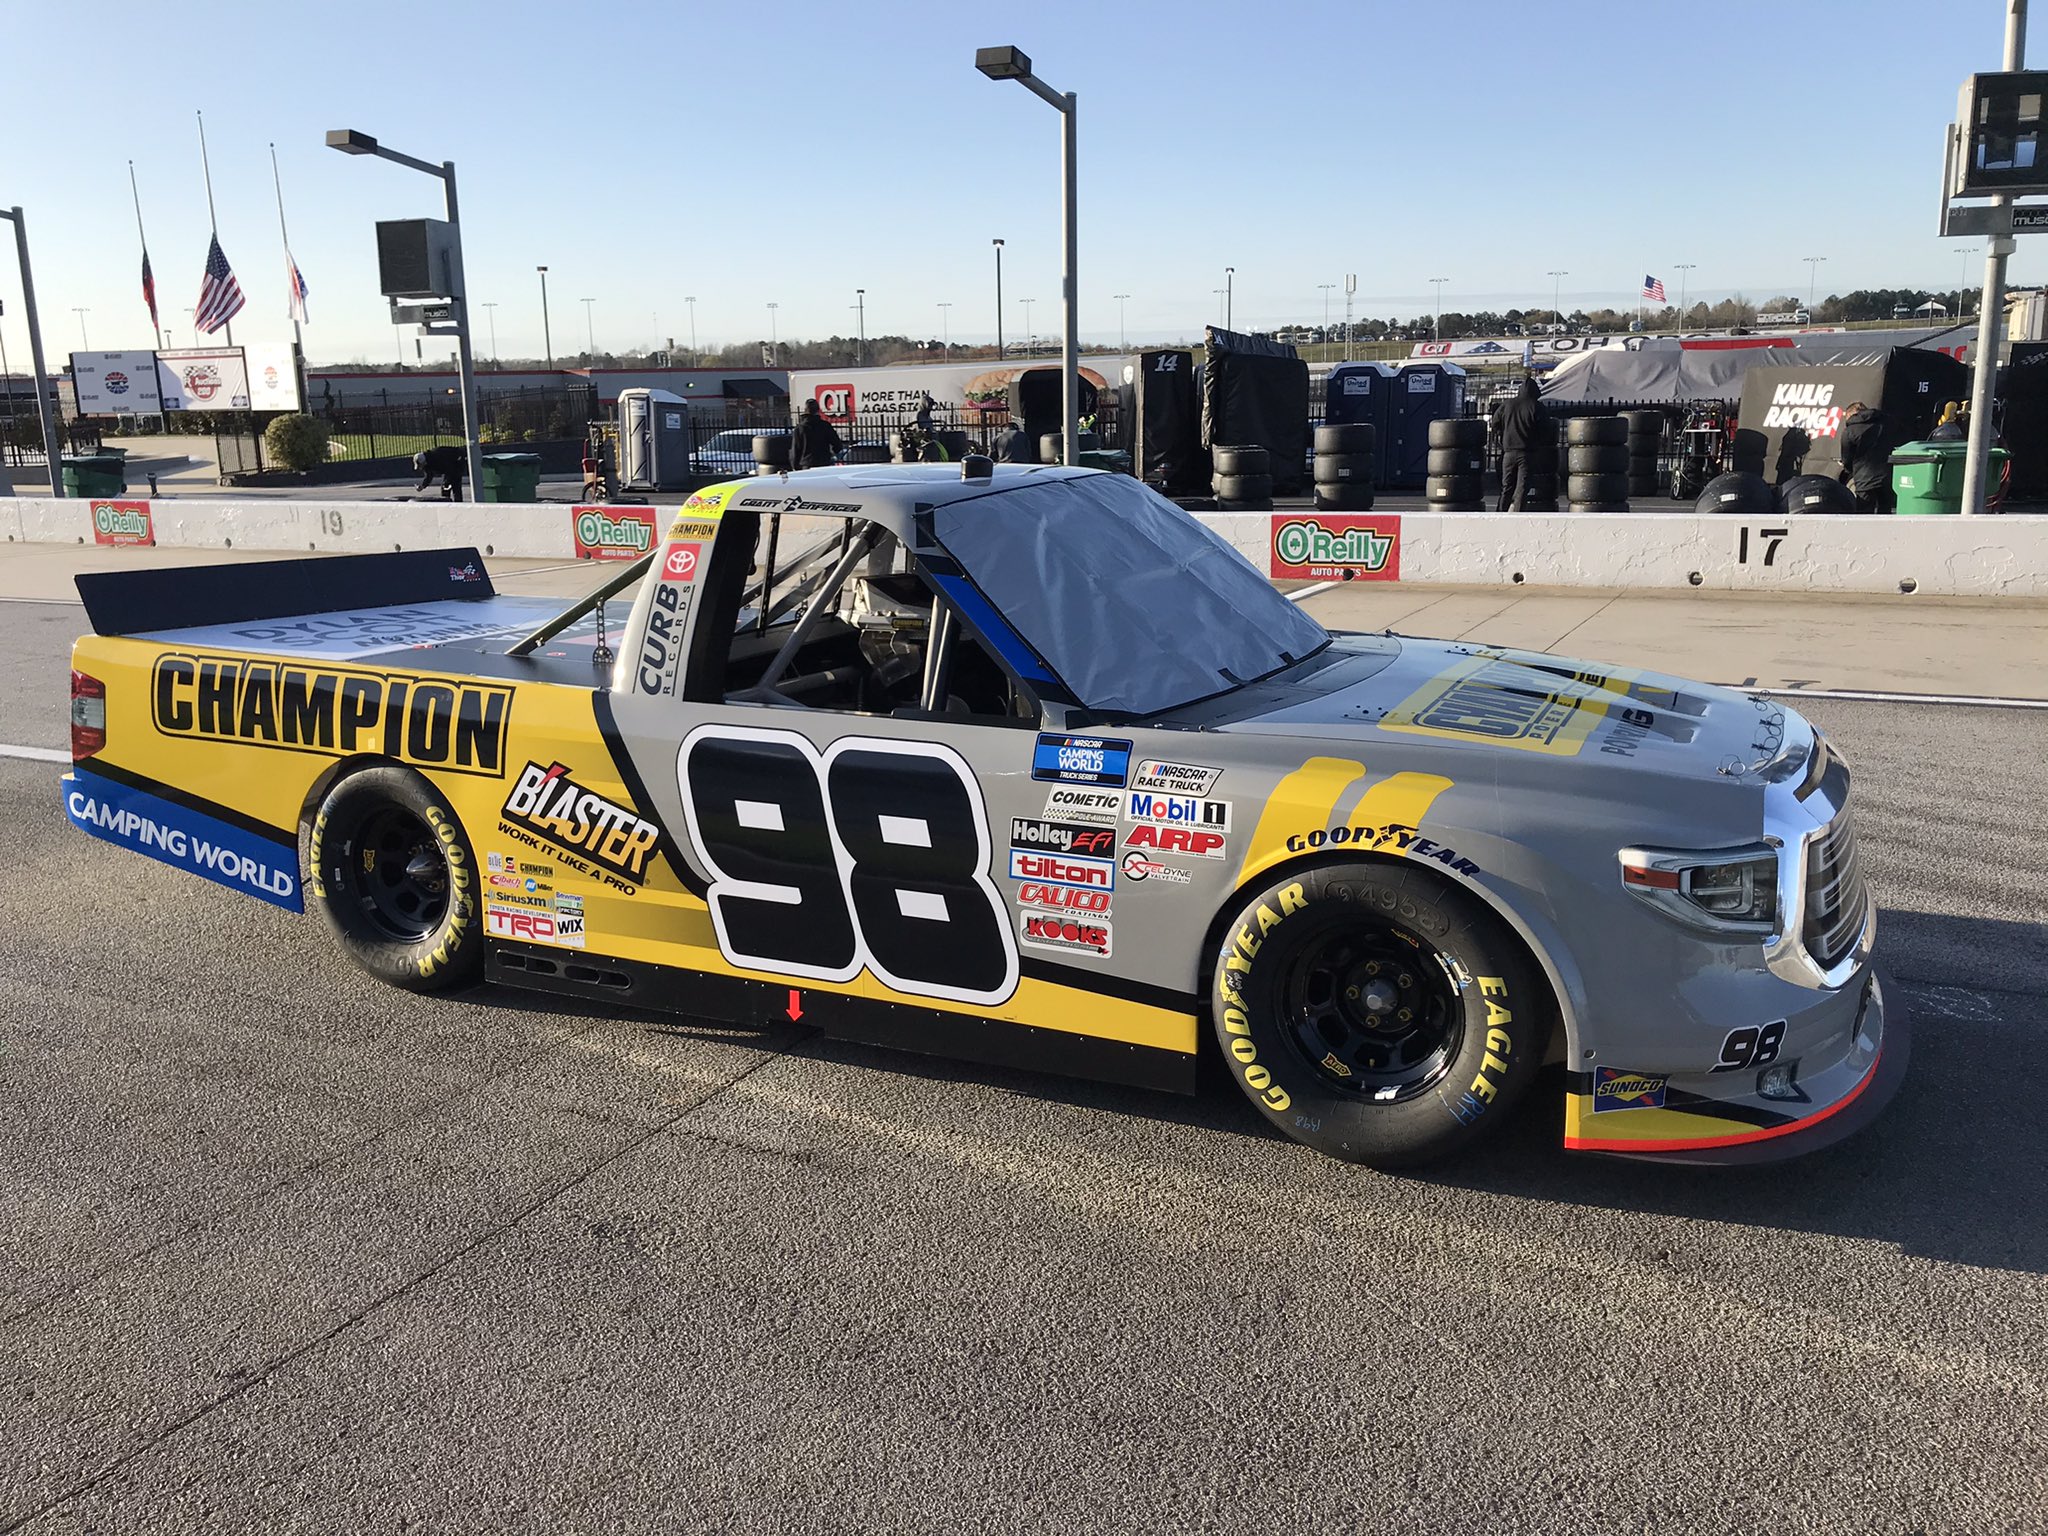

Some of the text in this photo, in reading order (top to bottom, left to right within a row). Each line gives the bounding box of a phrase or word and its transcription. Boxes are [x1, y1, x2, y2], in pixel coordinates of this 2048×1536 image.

[1154, 354, 1178, 372] 14
[861, 390, 930, 402] MORE THAN
[1773, 384, 1835, 404] KAULIG
[1918, 381, 1929, 393] 16
[818, 389, 851, 413] QT
[862, 404, 870, 413] A
[872, 403, 896, 414] GAS
[1763, 406, 1828, 429] RACING
[739, 498, 863, 513] GRANT ENFINGER
[96, 506, 148, 537] O'Reilly
[320, 510, 343, 536] 19
[580, 512, 648, 549] O'Reilly
[617, 549, 635, 557] PARTS
[1281, 526, 1385, 566] O'Reilly
[1738, 526, 1788, 566] 17
[1311, 567, 1332, 576] AUTO
[231, 609, 434, 641] DYLAN
[640, 583, 679, 696] CURB
[662, 585, 691, 695] RECORDS
[158, 659, 504, 769] CHAMPION
[1058, 747, 1104, 761] CAMPING
[1072, 739, 1104, 748] NASCAR
[1058, 757, 1103, 771] WORLD
[1059, 771, 1099, 781] TRUCK SERIES
[1160, 765, 1208, 781] NASCAR
[1138, 776, 1205, 792] RACE TRUCK
[1052, 791, 1120, 809] COMETIC
[1131, 793, 1197, 822] Mobil
[1013, 820, 1073, 852] Holley
[1072, 831, 1114, 853] EFI
[1125, 824, 1225, 854] ARP
[1190, 822, 1225, 831] LUBRICANTS
[69, 791, 293, 898] CAMPING WORLD
[310, 808, 329, 899] EAGLE
[1286, 823, 1482, 878] GOODYEAR
[498, 821, 540, 849] WORK
[540, 843, 556, 856] IT
[556, 850, 590, 874] LIKE
[589, 869, 600, 880] A
[603, 874, 637, 897] PRO
[676, 723, 1021, 1006] 98
[1017, 855, 1107, 886] tilton
[490, 874, 521, 889] Eibach
[1150, 873, 1190, 883] VALVETRAIN
[417, 805, 475, 978] GOODYEAR
[1019, 882, 1110, 914] CALICO
[489, 910, 554, 940] TRD
[557, 918, 584, 935] WIX
[1064, 908, 1109, 920] COATINGS
[1026, 917, 1108, 946] KOOKS
[1223, 882, 1309, 1112] GOODYEAR
[1470, 974, 1513, 1106] EAGLE
[1706, 1018, 1787, 1074] 98
[1327, 1058, 1347, 1074] AERO
[1597, 1080, 1664, 1097] SUNOCO
